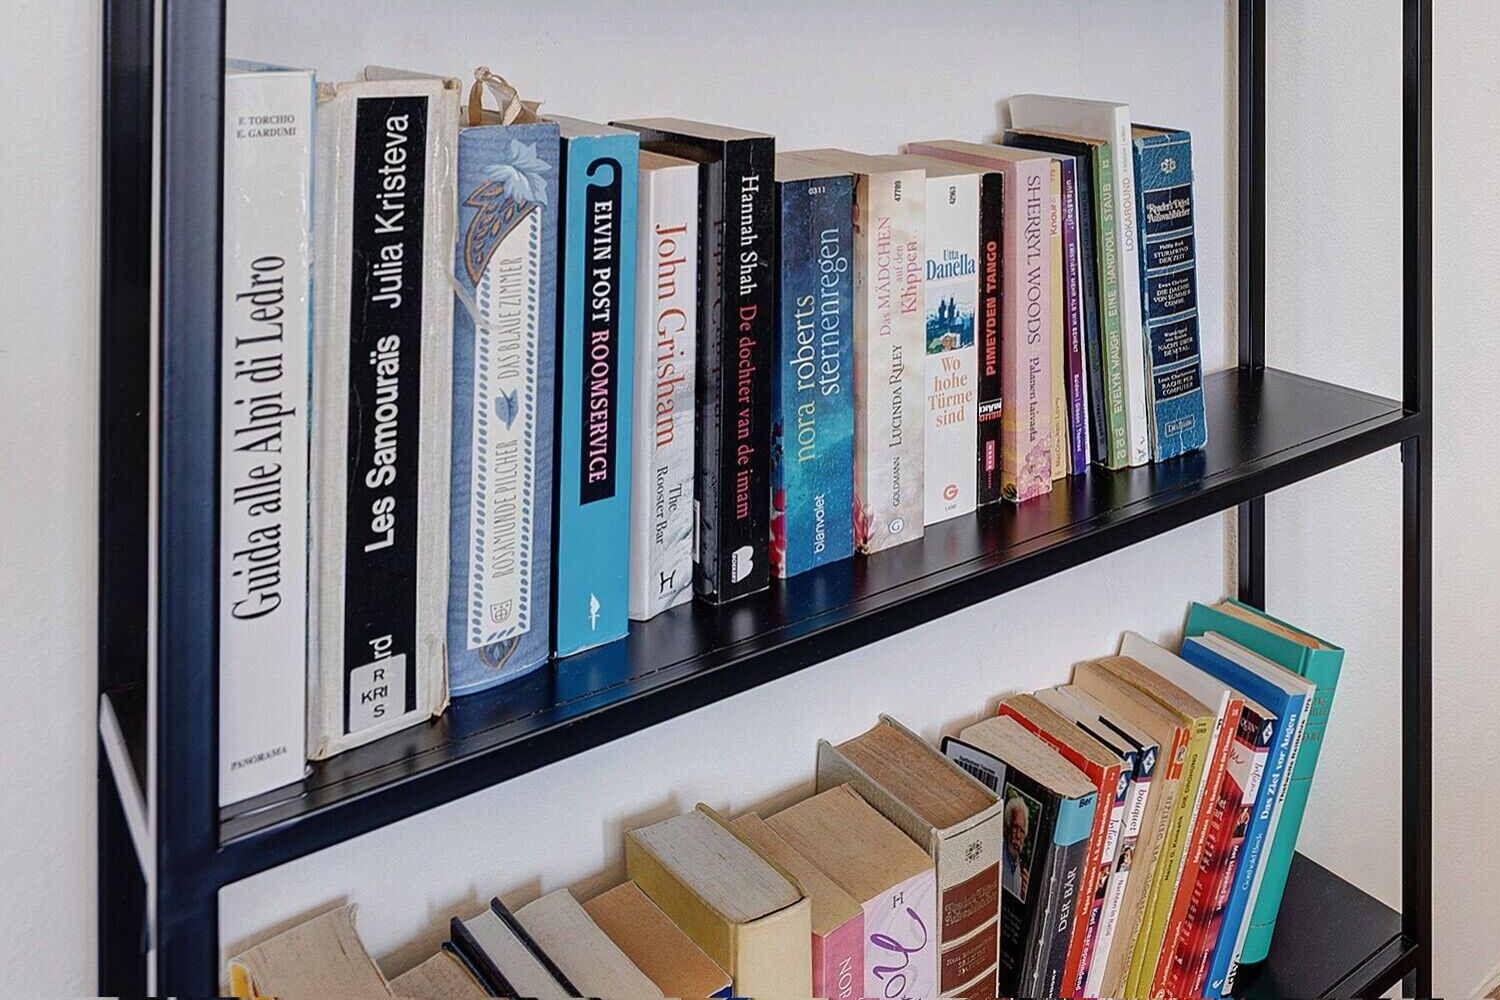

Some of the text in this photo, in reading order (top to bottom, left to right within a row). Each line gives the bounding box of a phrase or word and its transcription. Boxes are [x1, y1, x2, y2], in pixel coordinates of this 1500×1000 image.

[248, 114, 295, 125] TORCHIO
[248, 127, 296, 138] GARDUMI
[372, 114, 409, 309] Julia Kristeva
[1122, 177, 1135, 251] LOOKAROUND
[499, 257, 522, 307] ZIMMER
[875, 217, 891, 337] Das MÄDCHEN
[927, 254, 976, 280] Danella
[1026, 175, 1042, 345] SHERRYL WOODS
[821, 227, 848, 395] sternenregen
[986, 240, 997, 376] PIMEYDEN TANGO
[1103, 184, 1123, 413] EVELYN WAUGH EINE HANDVOLL STAUB
[497, 355, 520, 379] DAS
[588, 200, 613, 483] ELVIN POST ROOMSERVICE
[655, 223, 687, 449] John Grisham
[736, 175, 760, 521] Hannah Shah De dochter van de imam
[941, 356, 961, 373] Wo
[790, 294, 816, 465] nora roberts
[889, 345, 905, 448] LUCINDA RILEY
[928, 390, 972, 411] Türme
[934, 373, 968, 393] hohe
[232, 255, 296, 620] Guida alle Alpi di Ledro
[365, 334, 400, 552] Les Samouraïs
[936, 406, 965, 428] sind
[492, 439, 518, 578] ROSAMUNDE PILCHER
[655, 466, 668, 545] Rooster Bar
[668, 483, 682, 511] The
[814, 494, 825, 555] blanvalet
[361, 685, 389, 704] KRI
[373, 704, 385, 717] S
[374, 669, 384, 682] R
[1260, 713, 1298, 820] Das Ziel vor Augen
[1129, 788, 1147, 832] bouquet
[1254, 833, 1264, 856] Beck
[1058, 866, 1078, 932] DER BÄR
